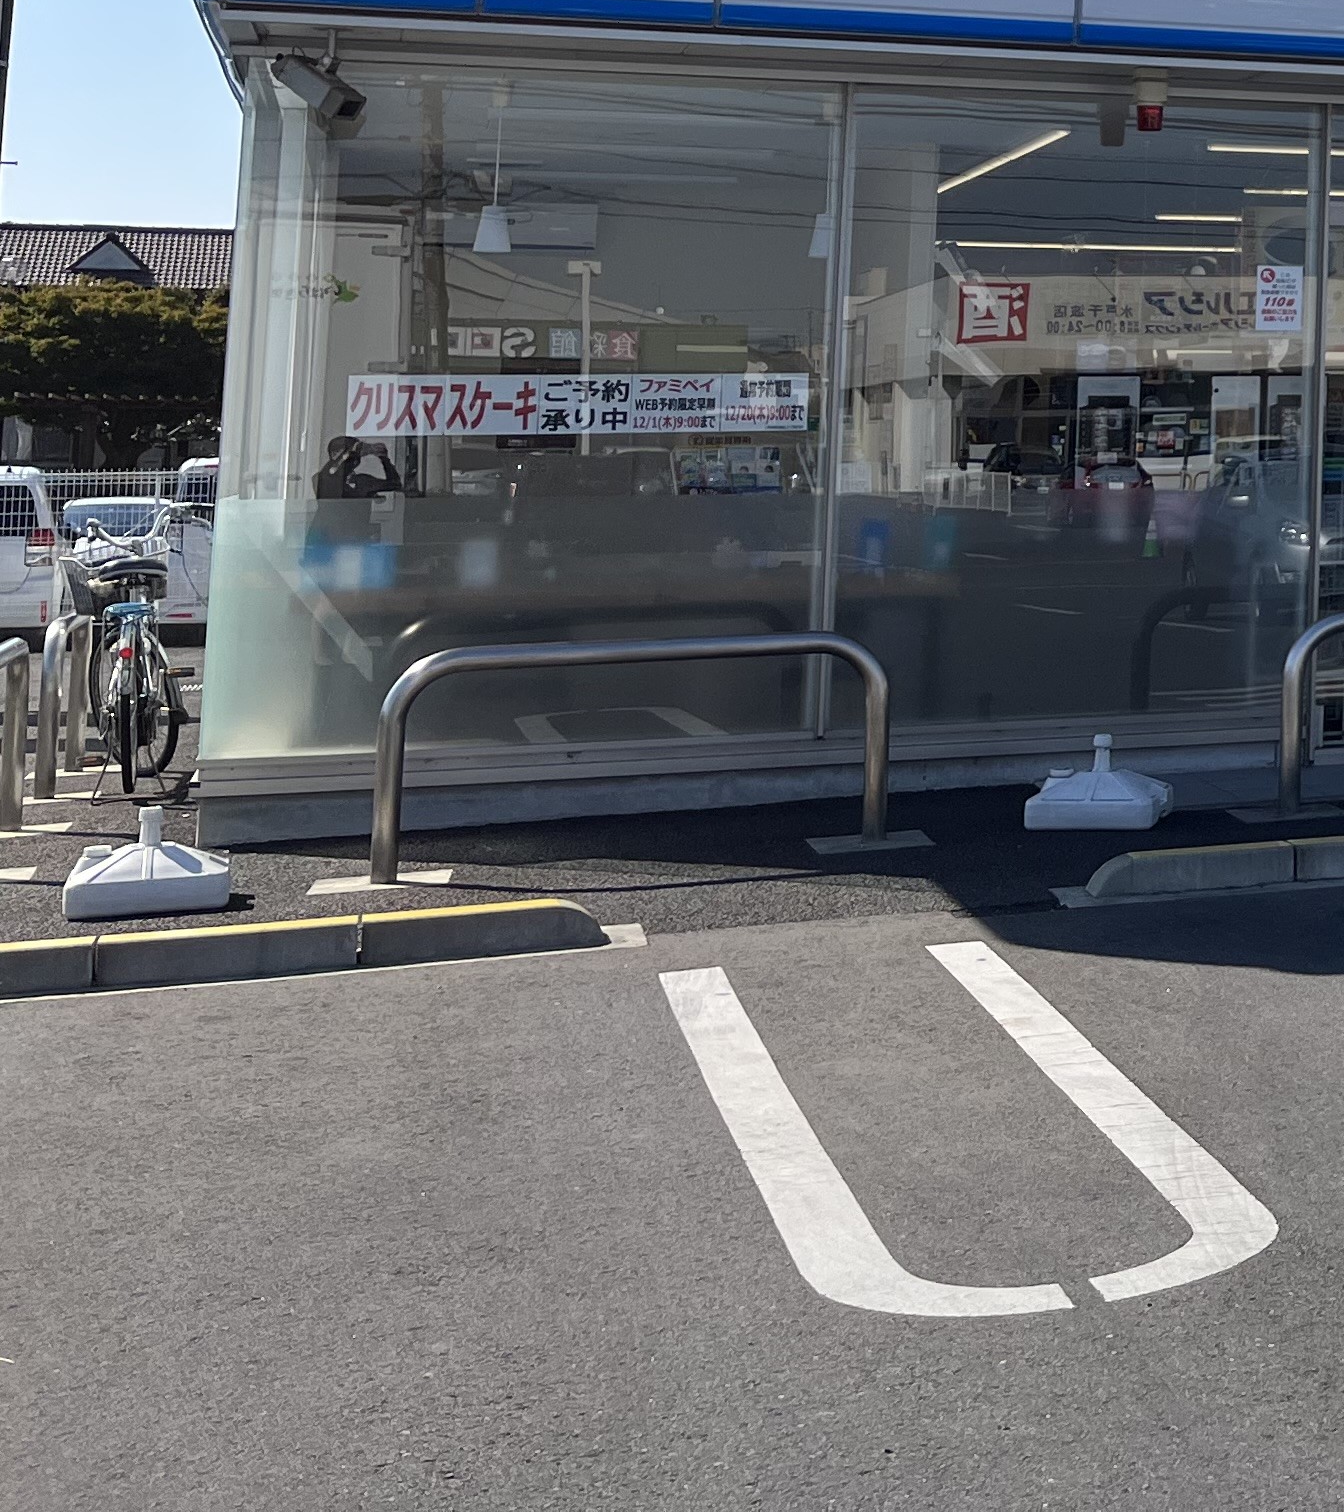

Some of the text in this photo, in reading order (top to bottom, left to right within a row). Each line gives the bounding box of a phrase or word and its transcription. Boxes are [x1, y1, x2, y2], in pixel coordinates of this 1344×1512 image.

[543, 379, 630, 403] ご予約
[640, 378, 715, 393] ファミペイ
[350, 379, 537, 431] クリスマスケーキ
[541, 407, 628, 431] 承り中
